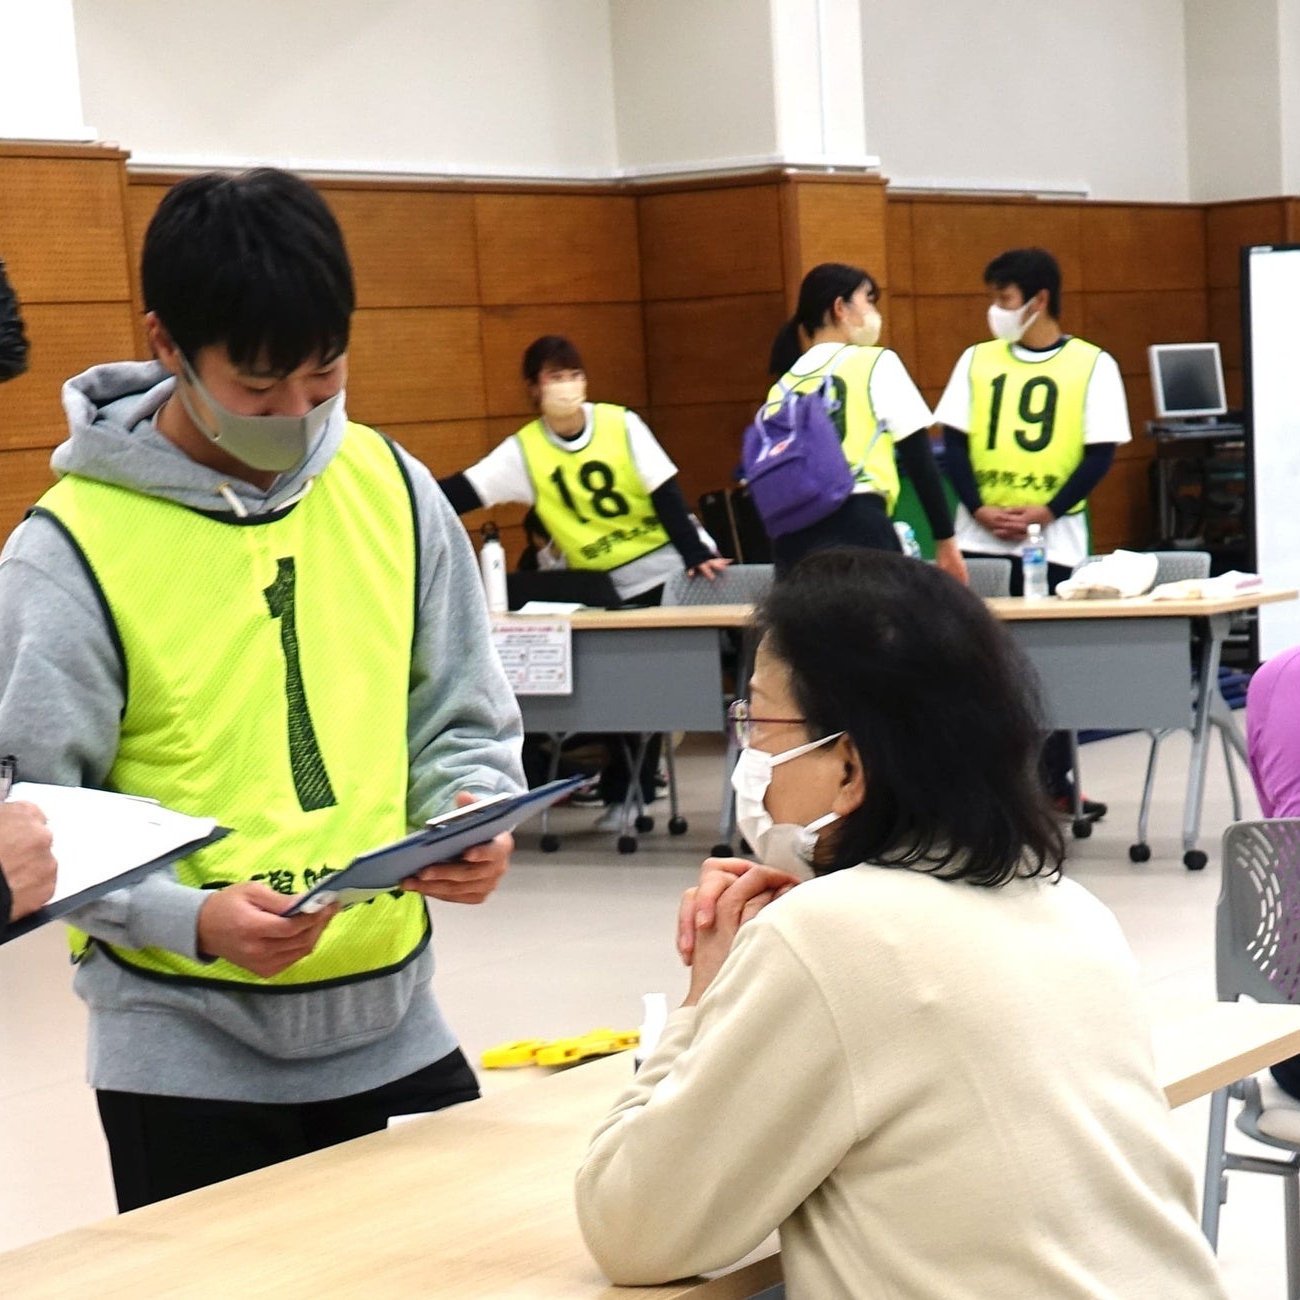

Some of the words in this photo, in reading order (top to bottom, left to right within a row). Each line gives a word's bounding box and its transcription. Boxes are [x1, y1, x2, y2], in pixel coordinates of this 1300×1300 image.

[986, 373, 1060, 453] 19
[550, 460, 630, 524] 18
[262, 556, 340, 813] 1
